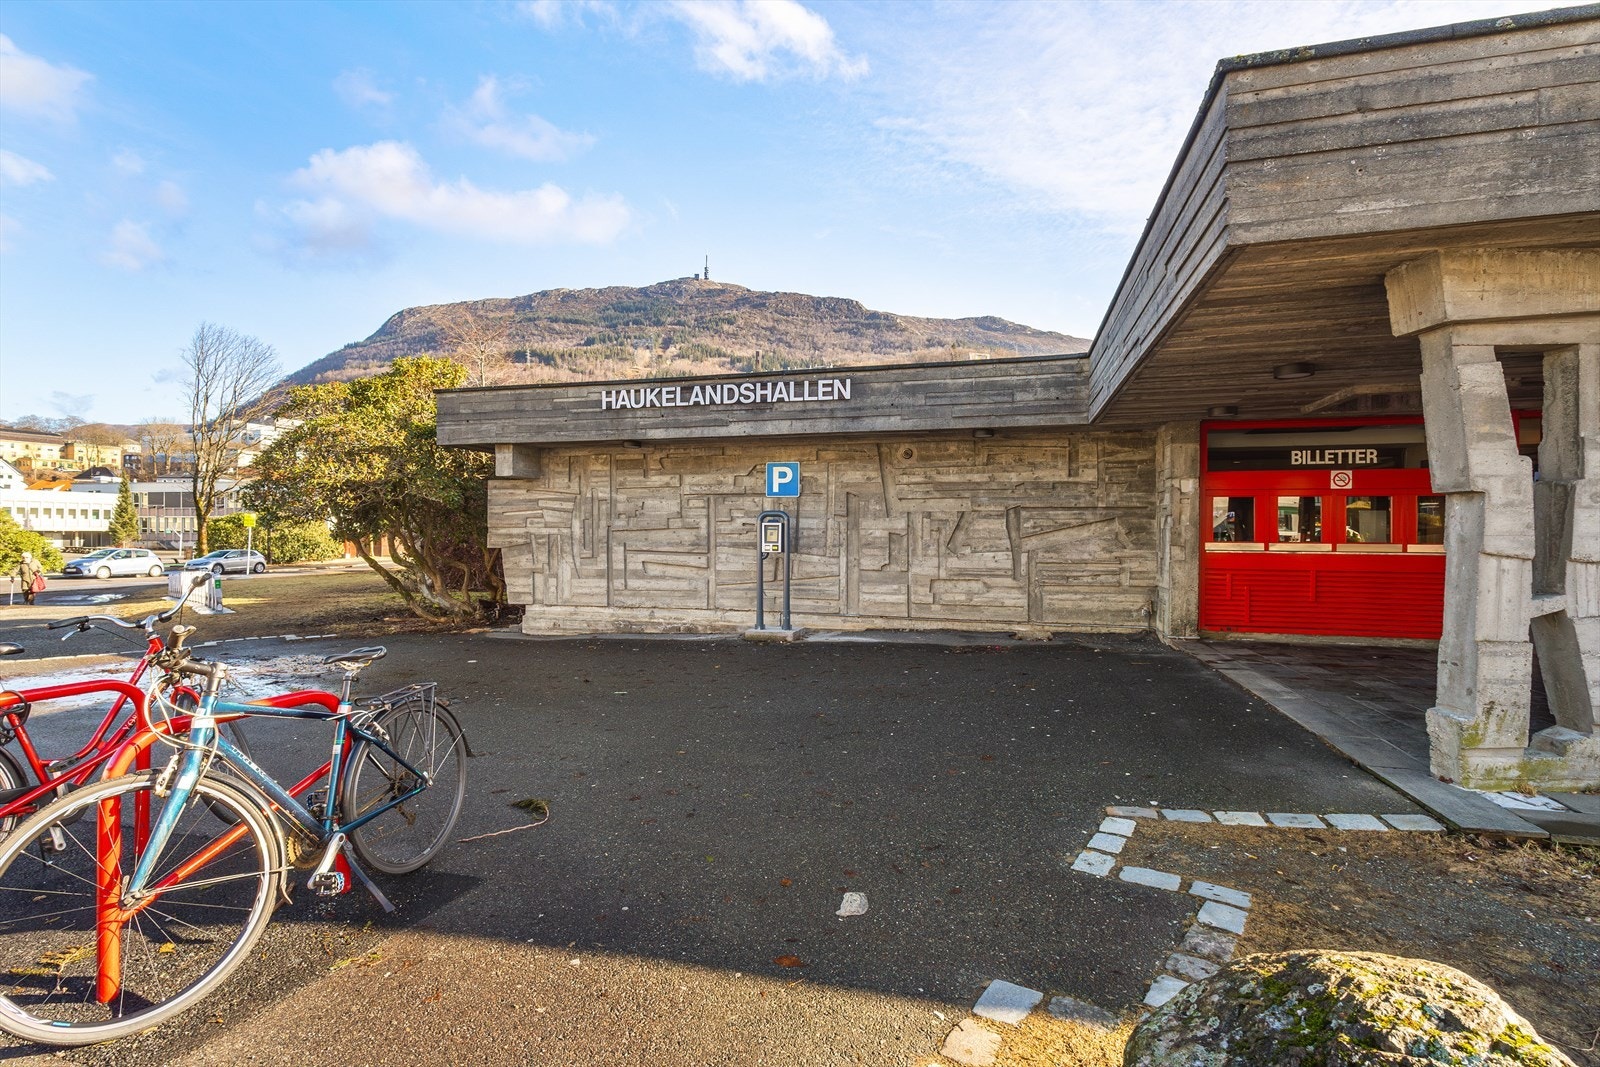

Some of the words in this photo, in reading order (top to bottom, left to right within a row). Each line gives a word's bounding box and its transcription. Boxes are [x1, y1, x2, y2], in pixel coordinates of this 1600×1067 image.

[601, 379, 851, 409] HAUKELANDSHALLEN
[1291, 449, 1378, 465] BILLETTER
[772, 466, 793, 493] P
